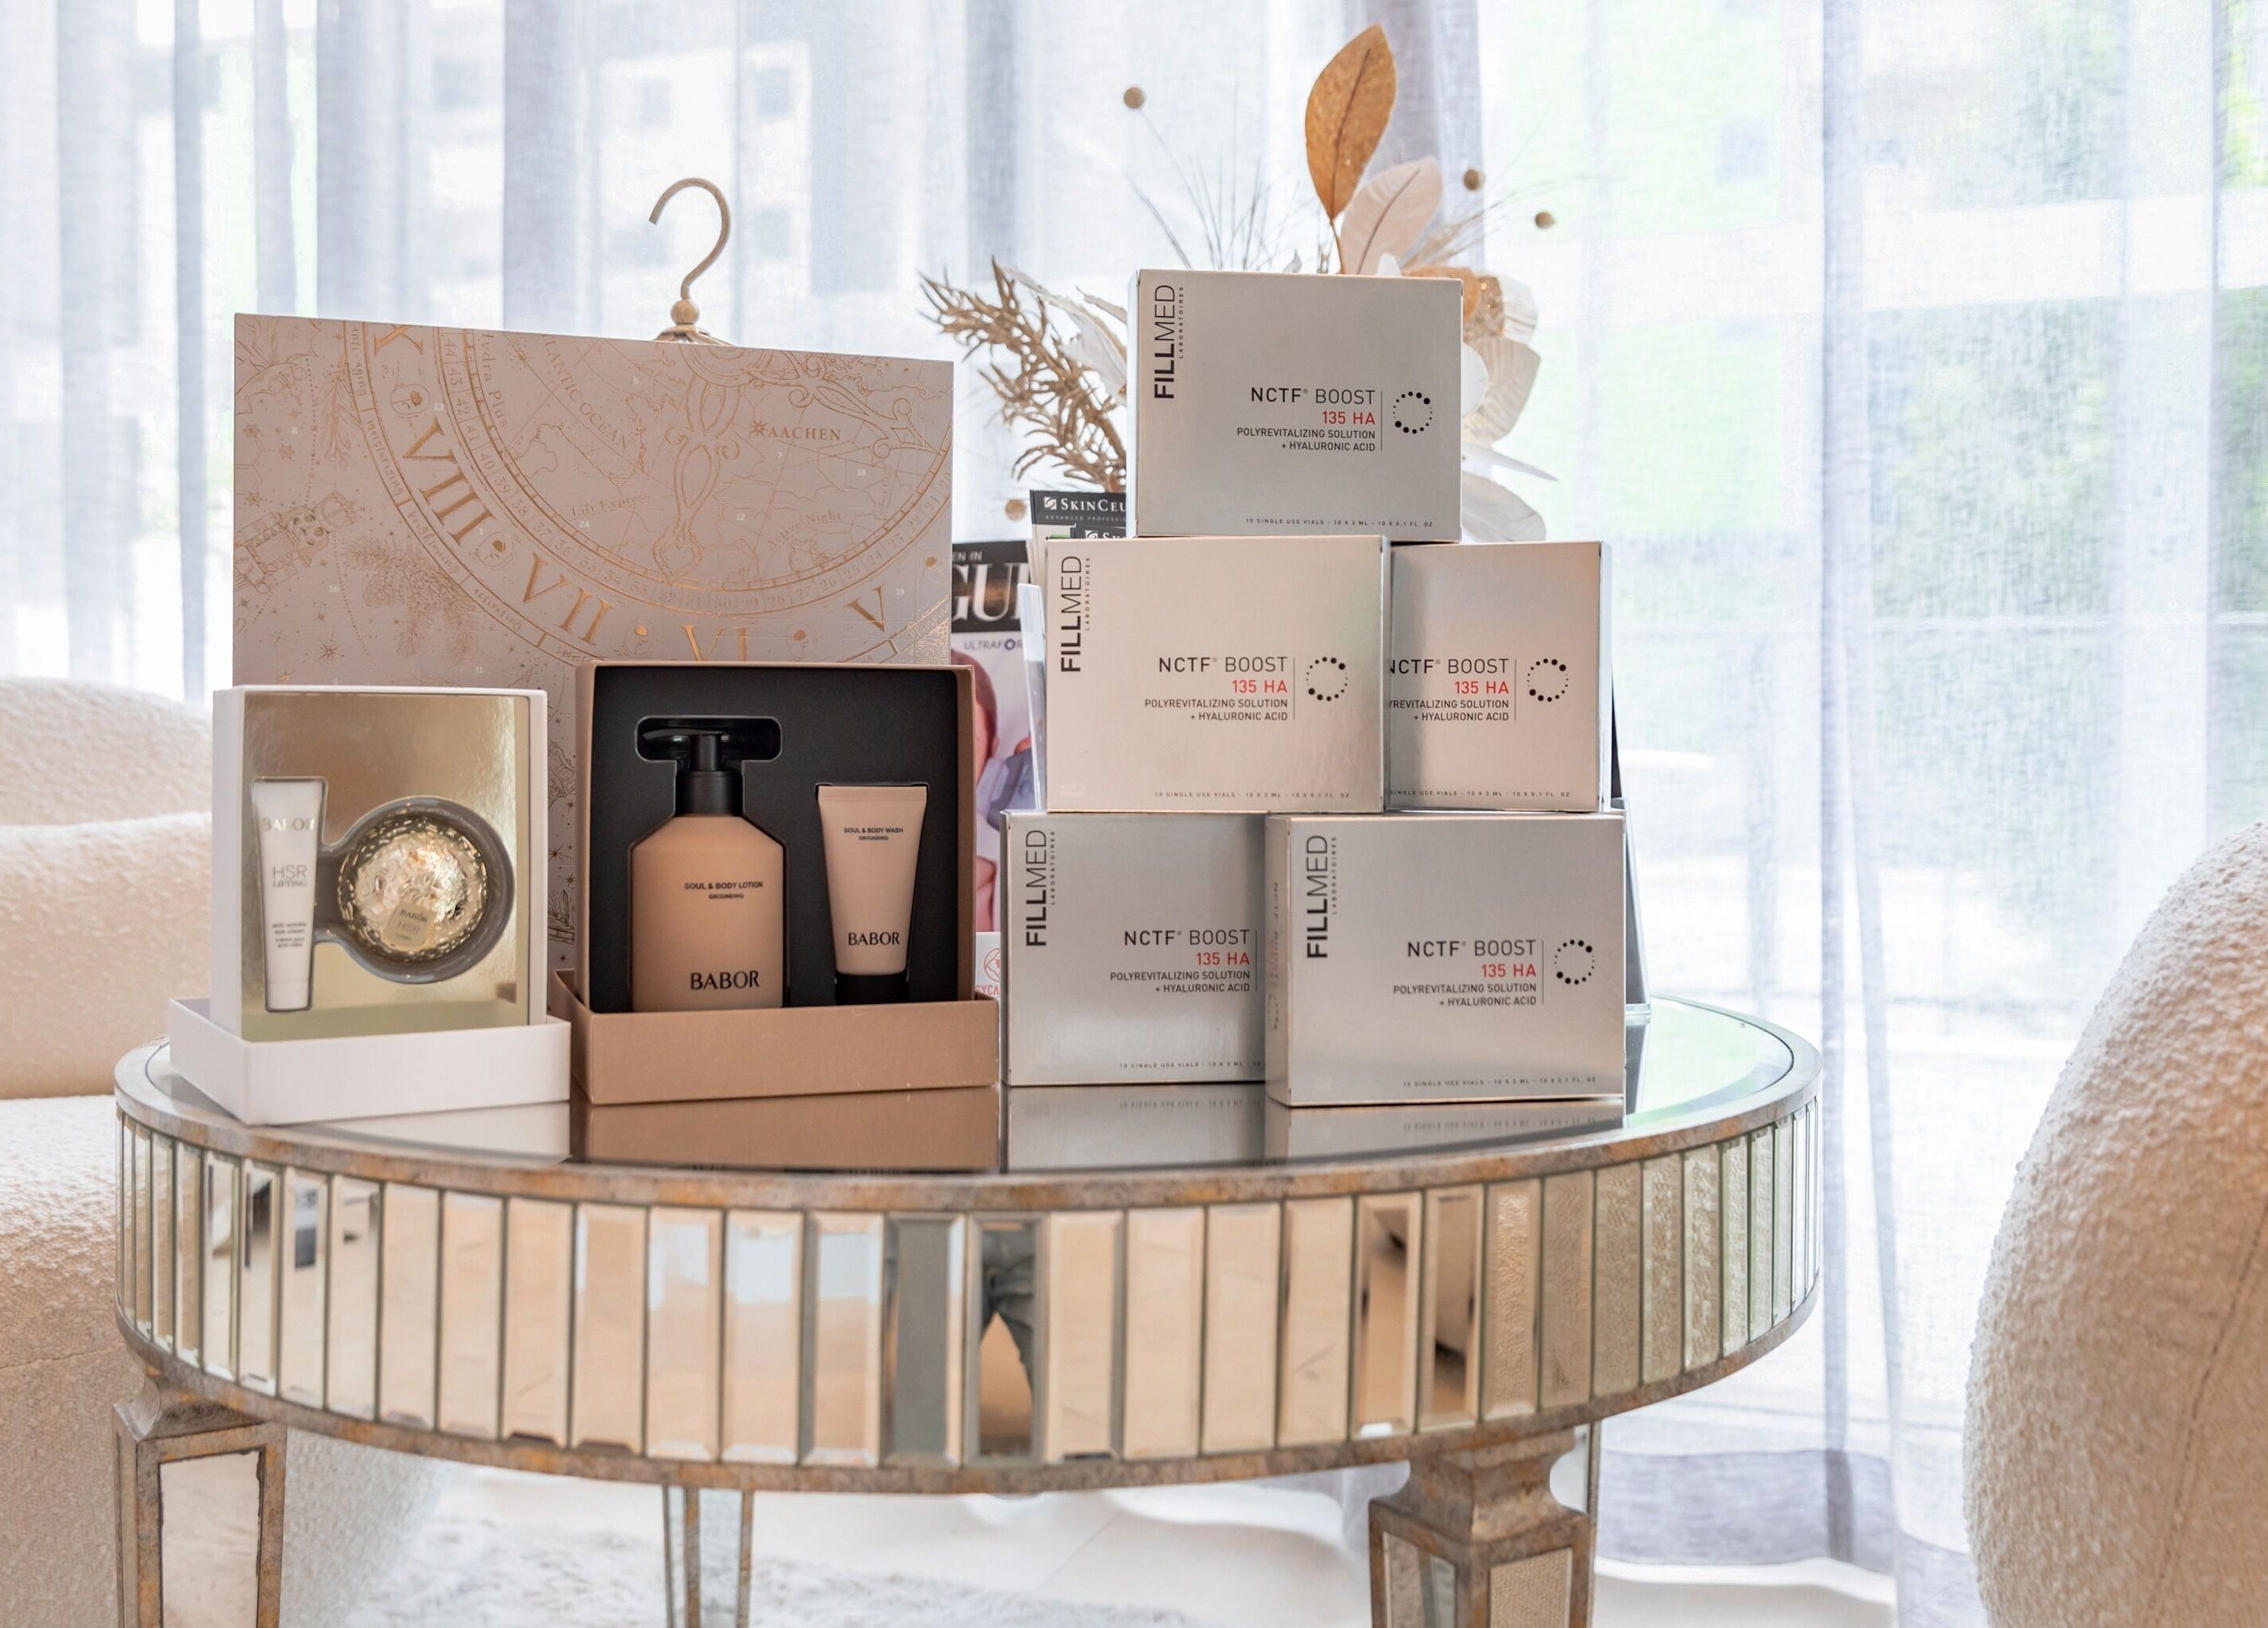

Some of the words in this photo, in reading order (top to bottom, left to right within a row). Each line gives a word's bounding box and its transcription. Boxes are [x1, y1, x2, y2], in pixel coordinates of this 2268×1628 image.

[1155, 285, 1175, 399] FILLMED
[448, 367, 463, 385] 43
[545, 340, 583, 401] LANTIC
[1316, 389, 1376, 404] BOOST
[1322, 411, 1346, 424] 135
[1354, 412, 1376, 425] HA
[768, 427, 841, 442] AACHEN
[1237, 427, 1325, 438] POLYREVITALIZING
[1327, 429, 1376, 439] SOLUTION
[1290, 441, 1350, 451] HYALURONIC
[1353, 442, 1376, 452] ACID
[403, 416, 498, 547] VIII
[523, 552, 615, 647] VII
[843, 585, 885, 633] V
[1061, 556, 1082, 671] FILLMED
[1225, 656, 1287, 673] BOOST
[1448, 658, 1509, 674] BOOST
[1232, 679, 1256, 693] 135
[1264, 679, 1287, 693] HA
[1455, 681, 1478, 694] 135
[1486, 681, 1509, 694] HA
[1145, 699, 1235, 709] POLYREVITALIZING
[1238, 699, 1287, 709] SOLUTION
[1460, 700, 1509, 709] SOLUTION
[1199, 712, 1261, 720] HYALURONIC
[1264, 712, 1288, 720] ACID
[1421, 712, 1483, 721] HYALURONIC
[1486, 712, 1509, 721] ACID
[272, 864, 307, 879] HSR
[1026, 830, 1046, 946] FILLMED
[1306, 836, 1327, 958] FILLMED
[848, 931, 900, 946] BABOR
[1189, 929, 1250, 946] BOOST
[1474, 939, 1536, 957] BOOST
[1196, 952, 1220, 965] 135
[1227, 951, 1250, 965] HA
[1110, 971, 1200, 981] POLYREVITALIZING
[1202, 970, 1250, 980] SOLUTION
[1481, 964, 1505, 977] 135
[1513, 963, 1537, 977] HA
[690, 969, 760, 991] BABOR
[1164, 983, 1226, 993] HYALURONIC
[1227, 983, 1250, 992] ACID
[1393, 984, 1485, 994] POLYREVITALIZING
[1488, 983, 1537, 993] SOLUTION
[1448, 997, 1511, 1006] HYALURONIC
[1513, 996, 1537, 1006] ACID
